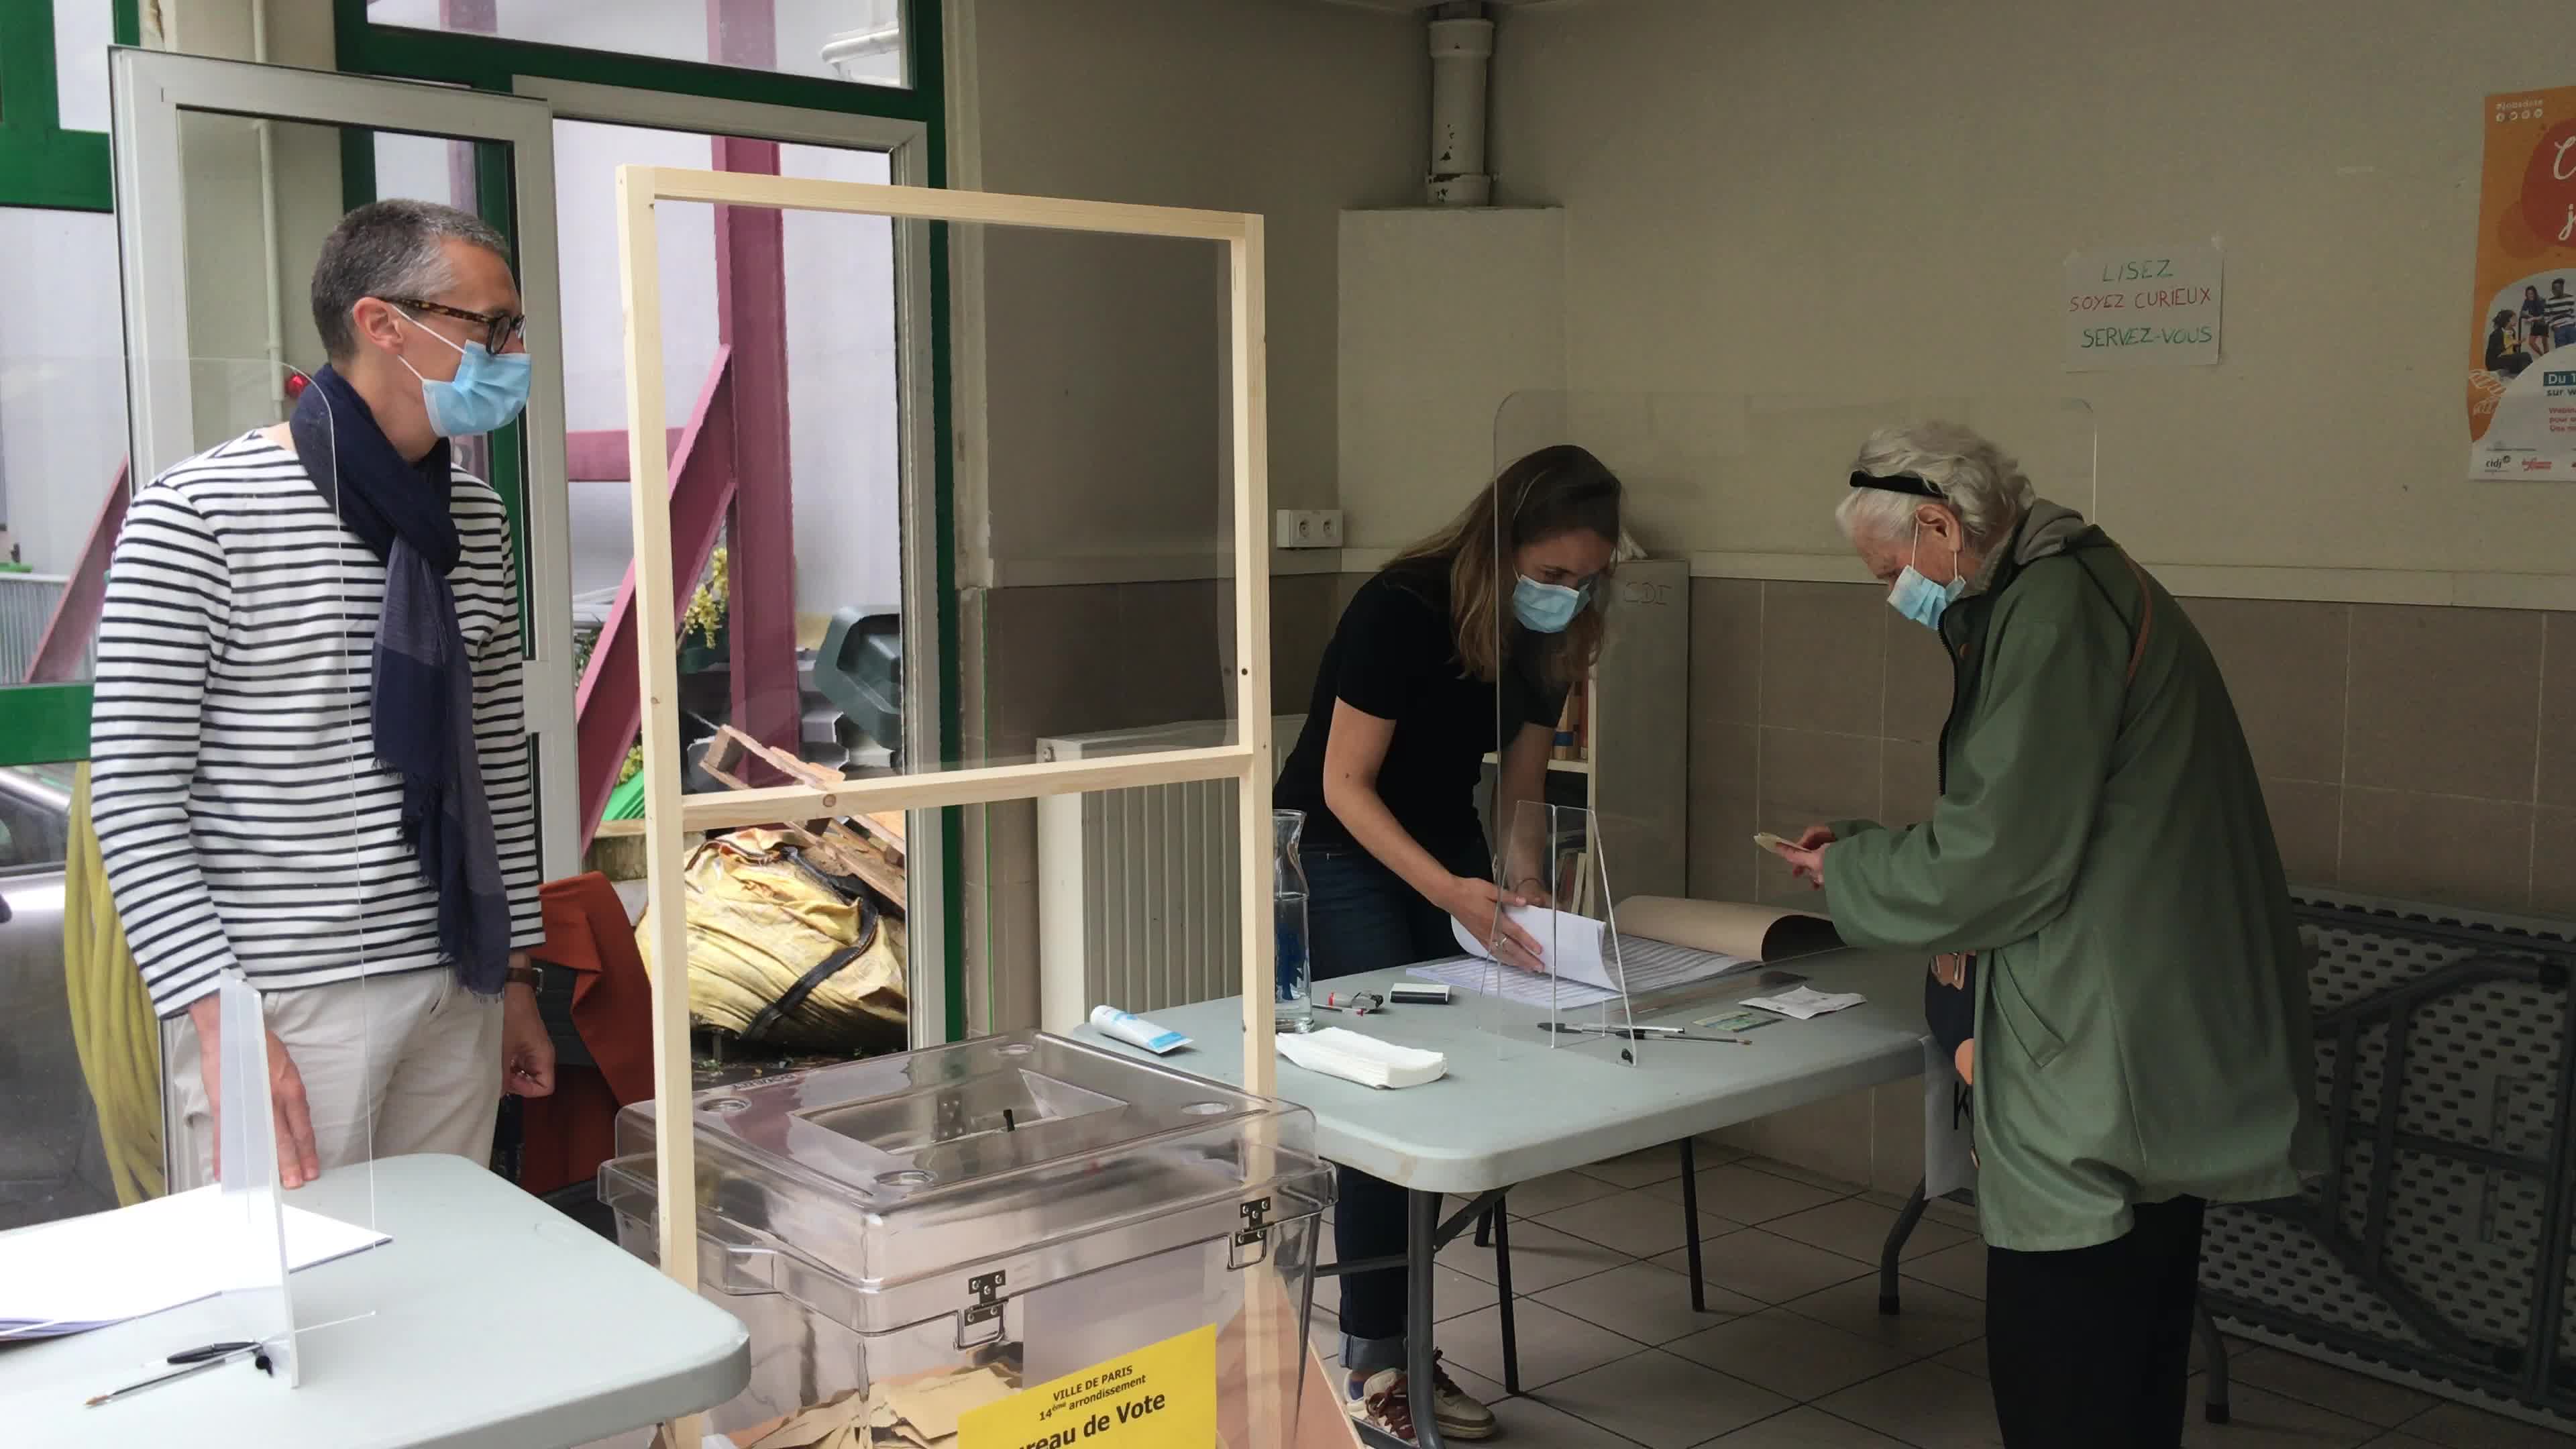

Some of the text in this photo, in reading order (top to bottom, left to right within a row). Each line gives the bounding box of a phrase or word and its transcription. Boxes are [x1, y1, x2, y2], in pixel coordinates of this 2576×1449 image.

[2102, 259, 2174, 282] LISEZ
[2070, 288, 2211, 311] SOYEZ CURIEUX
[2081, 326, 2212, 347] SERVEZ-VOUS
[2548, 374, 2566, 384] Du
[2547, 388, 2563, 396] sur
[1053, 1365, 1133, 1401] VILLE DE PARIS
[1069, 1375, 1146, 1410] arrondissement
[1083, 1413, 1110, 1438] de
[1116, 1393, 1165, 1424] Vote
